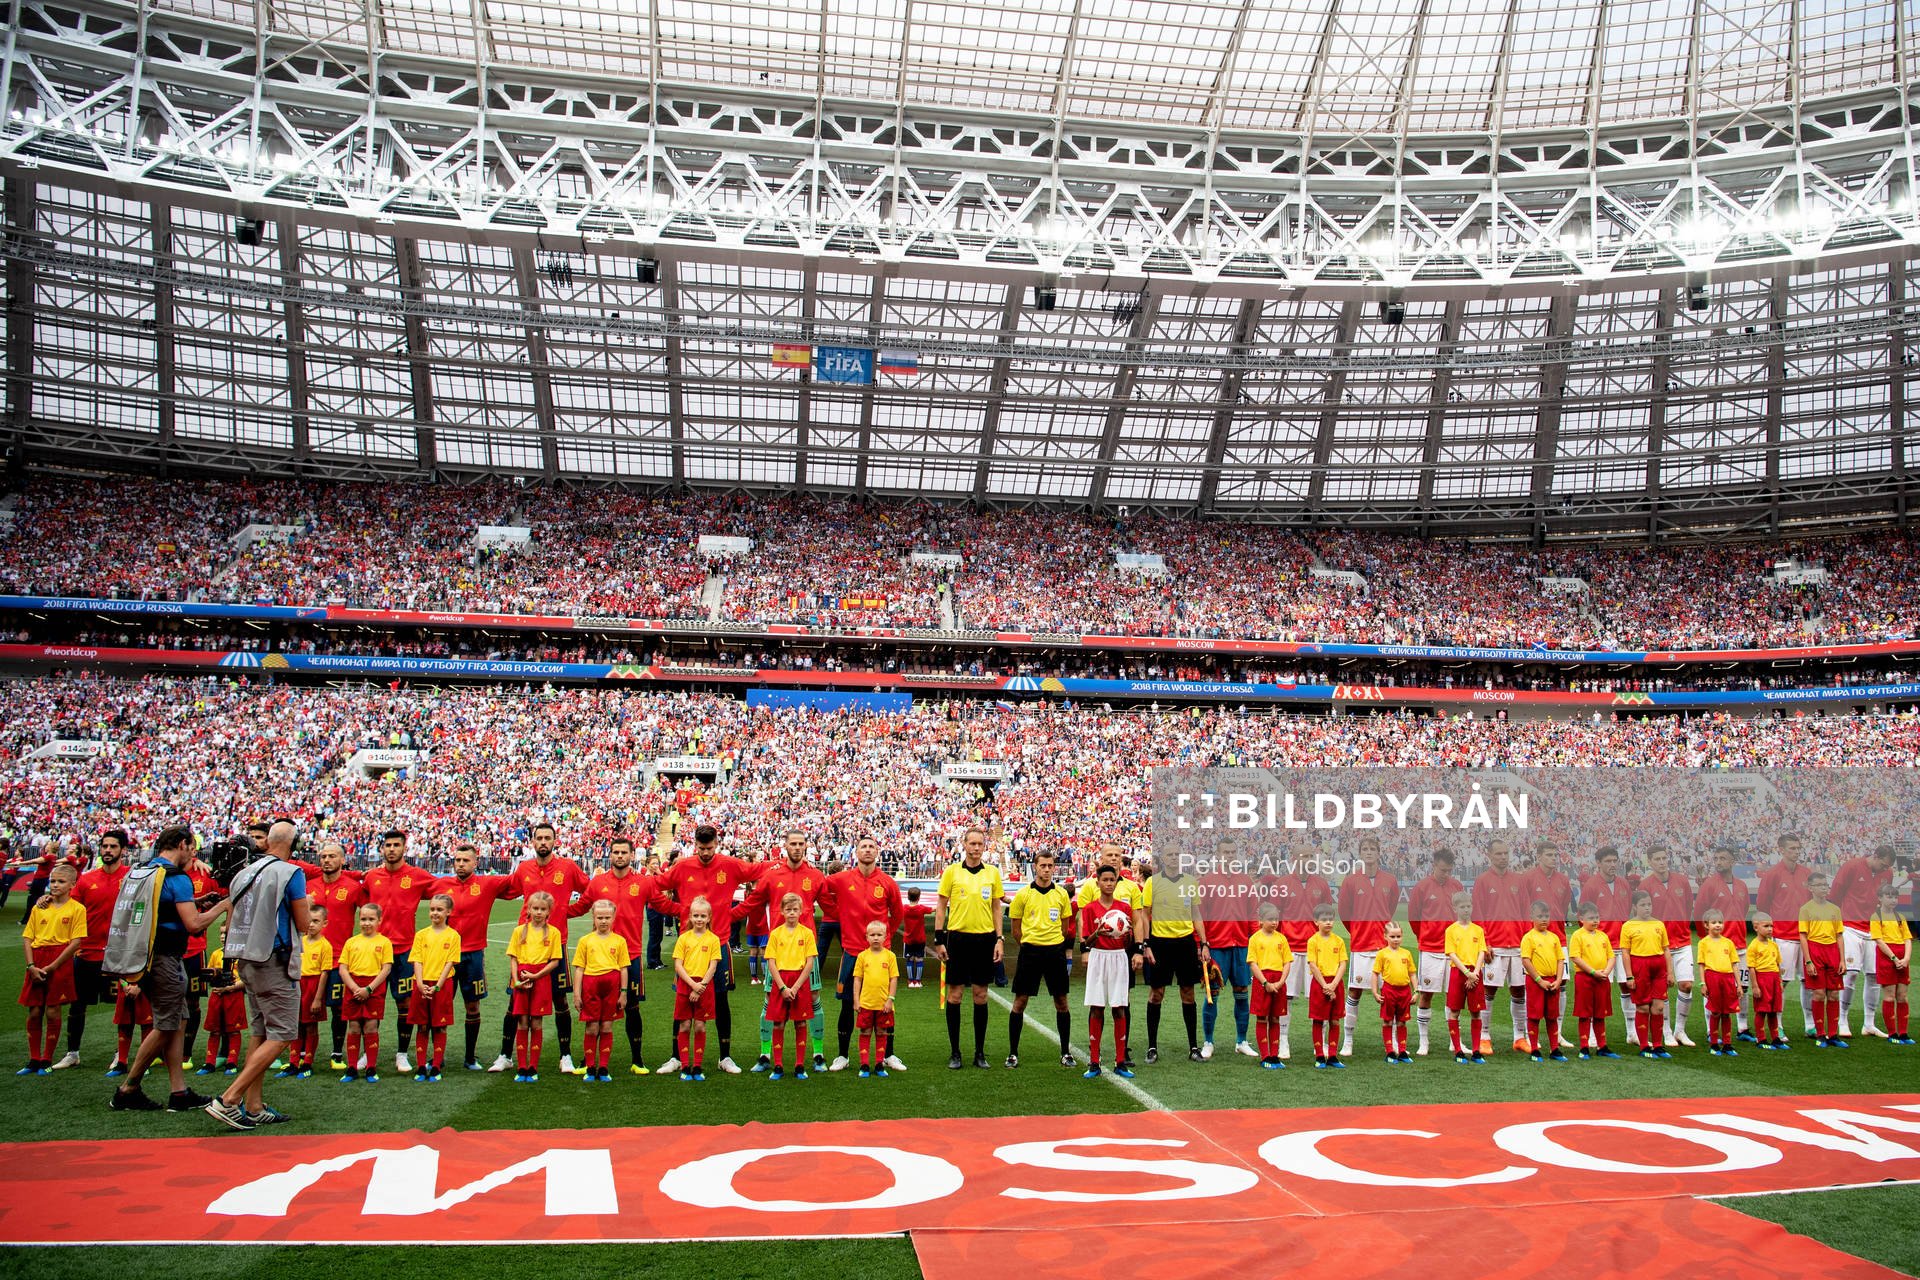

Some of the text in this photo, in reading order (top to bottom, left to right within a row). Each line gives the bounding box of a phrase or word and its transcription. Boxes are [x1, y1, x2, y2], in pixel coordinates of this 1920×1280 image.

[825, 353, 863, 372] FIFA
[43, 600, 183, 613] 2018 FIFA WORLD CUP RUSSIA
[1176, 640, 1214, 649] MOSCOW
[44, 646, 97, 658] #worldcup
[1378, 647, 1428, 655] ЧЕМПИОНАТ
[1430, 648, 1454, 656] МИРА
[1469, 650, 1506, 658] ФУТБОЛУ
[308, 657, 369, 666] ЧЕМПИОНАТ
[371, 659, 400, 668] МИРА
[403, 660, 417, 668] ПО
[420, 661, 466, 670] ФУТБОЛУ
[468, 662, 488, 671] FIFA
[523, 664, 563, 673] РОССИИ
[1131, 682, 1254, 693] 2018 FIFA WORLD CUP RUSSIA
[1763, 691, 1820, 699] ЧЕМПИОНАТ
[1822, 689, 1850, 697] МИРА
[1852, 688, 1865, 696] ПО
[1867, 686, 1912, 695] ФУТБОЛУ
[1473, 691, 1514, 700] MOSCOW
[398, 977, 412, 995] 20
[472, 979, 485, 995] 18
[557, 973, 566, 988] 5
[631, 981, 639, 996] 4
